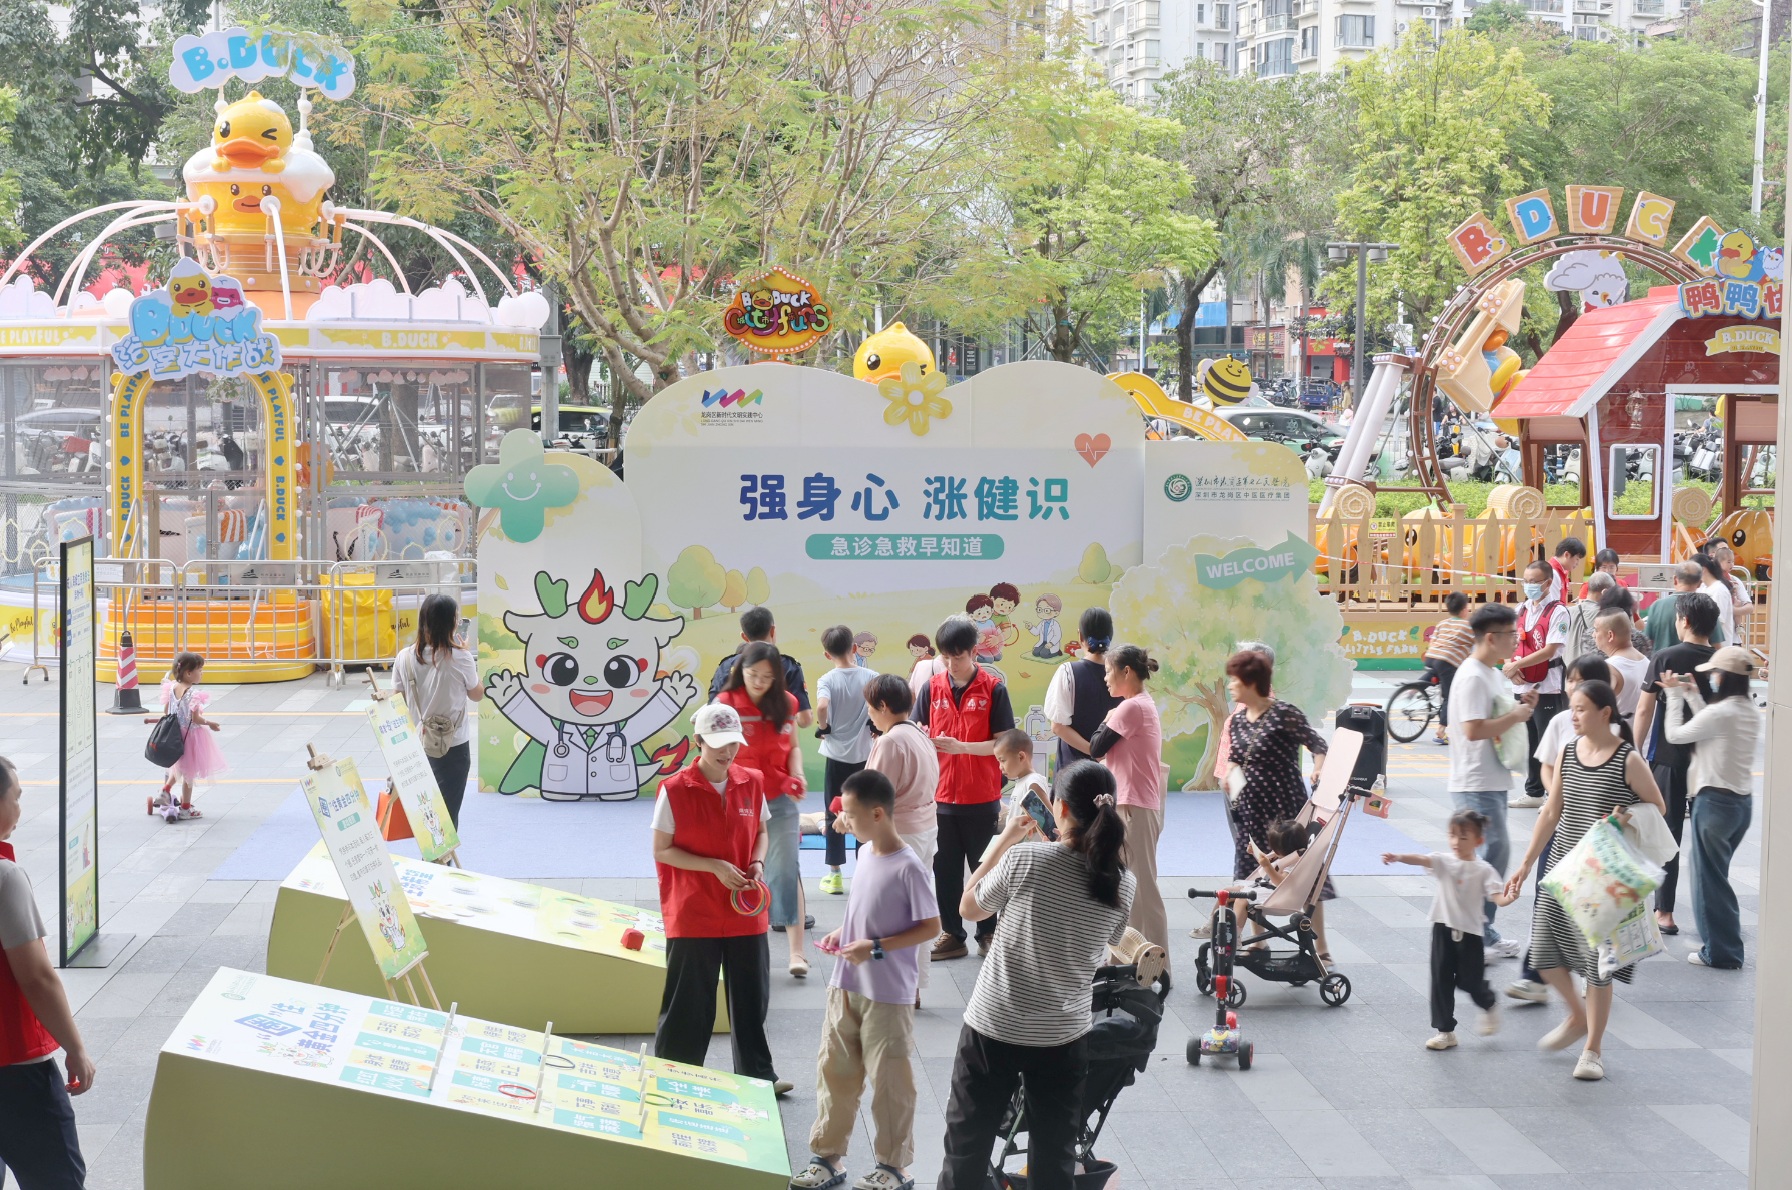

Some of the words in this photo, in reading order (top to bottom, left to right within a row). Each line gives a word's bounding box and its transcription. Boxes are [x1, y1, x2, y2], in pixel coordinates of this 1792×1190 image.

[133, 299, 257, 346] B.DUCK
[10, 330, 60, 344] PLAYFUL
[381, 332, 438, 347] B.DUCK
[1722, 330, 1775, 344] B.DUCK
[115, 336, 275, 375] 浴室大作战
[121, 369, 149, 417] PLAYFU
[268, 388, 285, 442] PLAYFUL
[1182, 406, 1203, 421] BE
[120, 423, 130, 437] BE
[275, 476, 286, 521] B.DUCK
[740, 472, 899, 521] 强身心
[923, 476, 1070, 521] 涨健识
[1195, 491, 1290, 499] 深圳市龙岗区中医医疗集团
[831, 536, 983, 557] 急诊急救早知道
[1206, 552, 1295, 578] WELCOME
[1352, 629, 1408, 643] B.DUCK
[1345, 643, 1383, 655] LITTLE
[1386, 644, 1418, 654] FARM
[297, 1002, 350, 1053] 黄金四分钟
